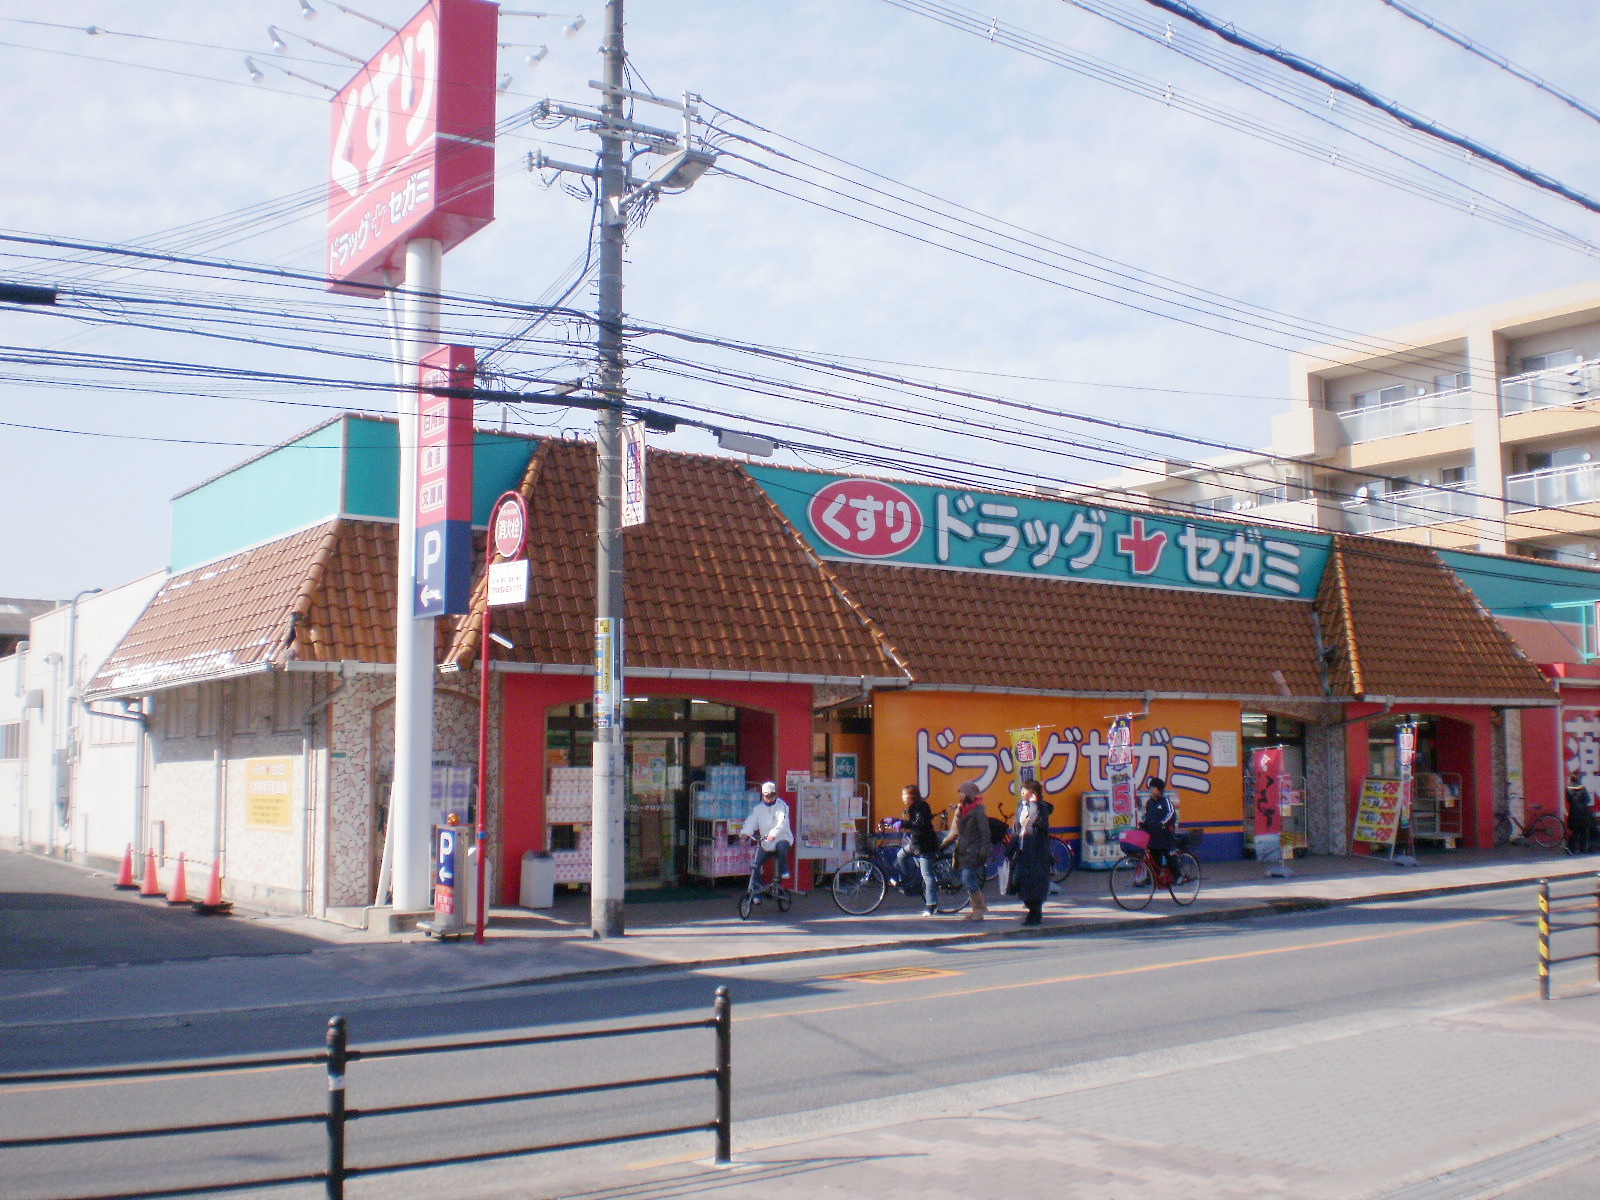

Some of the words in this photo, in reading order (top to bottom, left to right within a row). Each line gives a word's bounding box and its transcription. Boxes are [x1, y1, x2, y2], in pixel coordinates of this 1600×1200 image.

[331, 20, 435, 197] くすり
[329, 213, 371, 274] ドラッグ
[389, 168, 431, 224] セガミ
[498, 518, 520, 540] 消火栓
[821, 493, 912, 544] くすり
[936, 492, 1107, 571] ドラッグ
[1179, 522, 1301, 594] セガミ
[423, 529, 442, 580] P
[1112, 783, 1132, 814] 5
[440, 832, 453, 864] P
